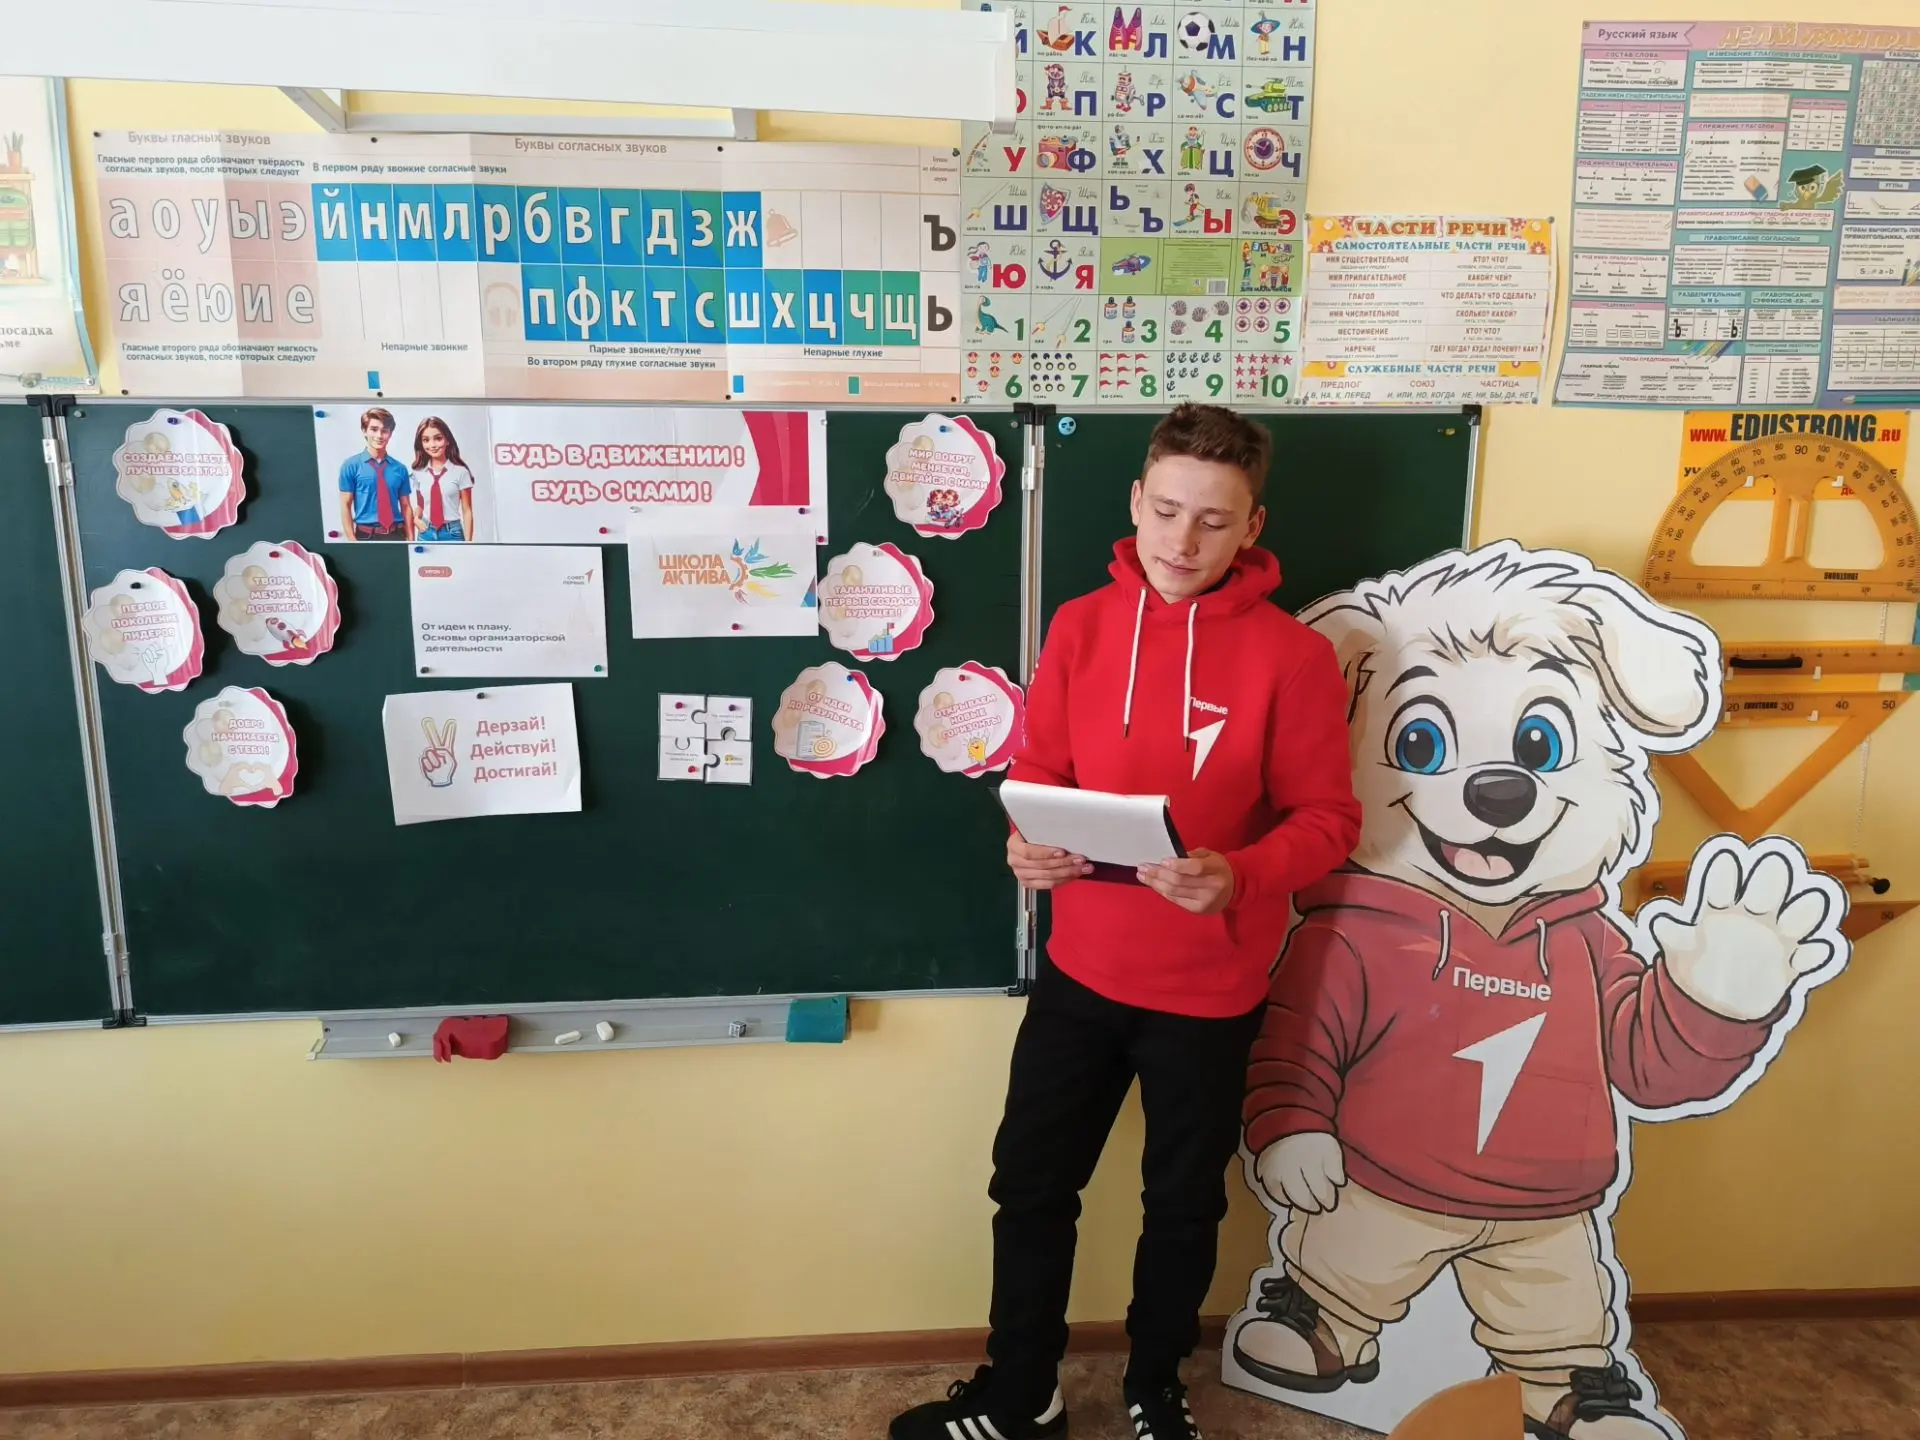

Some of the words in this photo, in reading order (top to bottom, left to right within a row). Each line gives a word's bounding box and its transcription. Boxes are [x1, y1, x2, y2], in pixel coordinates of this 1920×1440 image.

[1598, 28, 1646, 40] Русский
[1650, 30, 1678, 39] язык
[1075, 31, 1097, 56] К
[1144, 33, 1167, 58] Л
[1206, 34, 1236, 60] М
[1283, 36, 1306, 61] Н
[1075, 91, 1097, 116] П
[1147, 93, 1166, 117] Р
[1216, 93, 1235, 118] С
[1287, 95, 1304, 120] Т
[128, 131, 168, 144] Буквы
[172, 133, 221, 143] гласных
[226, 134, 271, 146] звуков
[515, 138, 554, 151] Буквы
[558, 140, 622, 152] согласных
[625, 142, 667, 155] звуков
[1003, 147, 1026, 172] У
[1068, 148, 1097, 173] Ф
[1142, 149, 1165, 174] Х
[1209, 150, 1234, 177] Ц
[1281, 152, 1301, 178] Ч
[313, 163, 319, 171] В
[322, 165, 358, 174] первом
[361, 165, 384, 175] ряду
[387, 165, 425, 173] звонкие
[428, 165, 476, 173] согласные
[479, 166, 507, 175] звуки
[994, 205, 1027, 230] Ш
[1062, 206, 1099, 235] Щ
[1204, 208, 1232, 233] Ы
[1277, 209, 1297, 235] Э
[1357, 222, 1435, 235] ЧАСТИ
[1448, 222, 1506, 235] РЕЧИ
[1335, 241, 1450, 250] САМОСТОЯТЕЛЬНЫЕ
[1456, 241, 1492, 250] ЧАСТИ
[1498, 242, 1525, 250] РЕЧИ
[1341, 256, 1409, 264] СУЩЕСТВИТЕЛЬНОЕ
[993, 263, 1026, 289] Ю
[1075, 264, 1094, 289] Я
[1014, 318, 1024, 341] 1
[1073, 319, 1091, 342] 2
[1140, 319, 1157, 343] 3
[1204, 320, 1223, 343] 4
[1273, 320, 1290, 343] 5
[381, 342, 428, 353] Непарные
[431, 343, 468, 352] звонкие
[803, 348, 850, 358] Непарные
[852, 349, 883, 358] глухие
[1348, 365, 1421, 373] СЛУЖЕБНЫЕ
[1427, 364, 1462, 373] ЧАСТИ
[1468, 364, 1496, 373] РЕЧИ
[1005, 374, 1023, 398] 6
[1071, 375, 1089, 397] 7
[1140, 374, 1157, 397] 8
[1206, 374, 1223, 397] 9
[1260, 374, 1289, 397] 10
[1320, 381, 1361, 389] ПРЕДЛОГ
[1410, 380, 1435, 388] СОЮЗ
[1480, 380, 1519, 388] ЧАСТИЦА
[122, 452, 183, 464] СОЗДАЁМ
[185, 453, 228, 464] ВМЕСТЕ
[495, 443, 563, 469] БУДЬ
[565, 444, 586, 467] В
[909, 449, 933, 459] МИР
[935, 452, 975, 464] ВОКРУГ
[1794, 445, 1808, 455] 90
[125, 465, 179, 476] ЛУЧШЕЕ
[912, 462, 970, 476] МЕНЯЕТСЯ,
[892, 471, 945, 485] ДВИГАЙСЯ
[948, 478, 956, 486] С
[532, 480, 601, 504] БУДЬ
[602, 481, 622, 502] С
[658, 554, 725, 570] ШКОЛА
[253, 576, 295, 586] ТВОРИ,
[662, 570, 731, 585] АКТИВА
[250, 588, 302, 600] МЕЧТАЙ,
[834, 586, 911, 594] ТАЛАНТЛИВЫЕ
[121, 602, 167, 612] ПЕРВОЕ
[826, 598, 869, 606] ПЕРВЫЕ
[870, 598, 920, 606] СОЗДАЮТ
[111, 614, 179, 628] ПОКОЛЕНИЕ
[421, 623, 436, 631] От
[438, 624, 466, 632] идеи
[477, 623, 512, 632] плану.
[122, 627, 176, 641] ЛИДЕРОВ
[422, 634, 467, 642] Основы
[469, 633, 566, 643] организаторской
[425, 645, 503, 653] деятельности
[809, 692, 822, 702] ОТ
[823, 697, 852, 712] ИДЕИ
[934, 694, 997, 718] ОТКРЫВАЕМ
[1727, 702, 1739, 712] 20
[1781, 701, 1794, 711] 30
[1836, 700, 1849, 710] 40
[1882, 700, 1896, 709] 50
[229, 719, 264, 729] ДОБРО
[788, 700, 804, 711] ДО
[803, 703, 864, 731] РЕЗУЛЬТАТА
[951, 708, 987, 725] НОВЫЕ
[475, 716, 546, 737] Дерзай!
[212, 733, 279, 742] НАЧИНАЕТСЯ
[228, 746, 236, 754] С
[470, 738, 558, 761] Действуй!
[473, 762, 558, 784] Достигай!
[1453, 967, 1551, 1001] Первые
